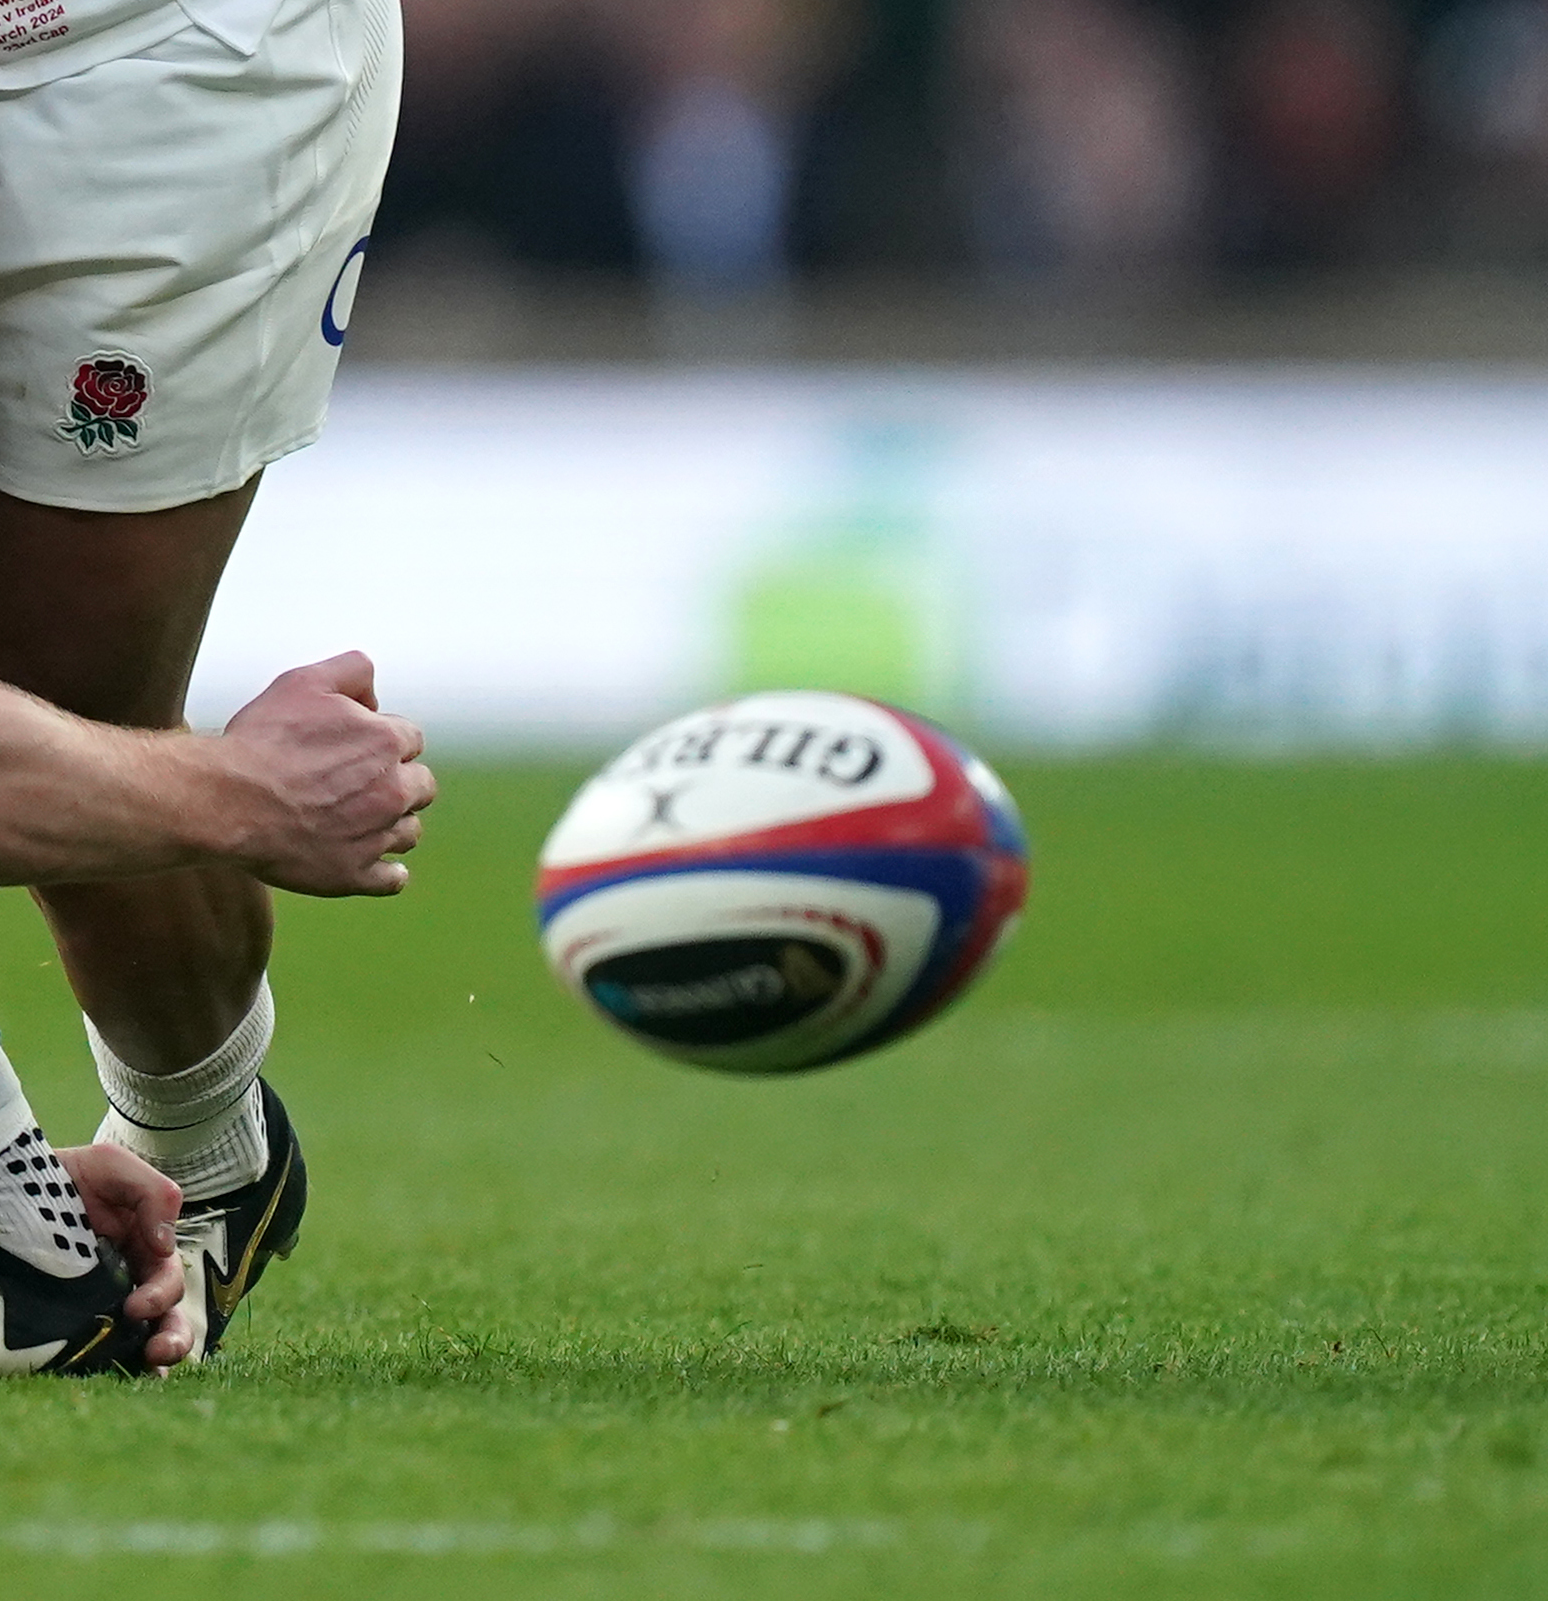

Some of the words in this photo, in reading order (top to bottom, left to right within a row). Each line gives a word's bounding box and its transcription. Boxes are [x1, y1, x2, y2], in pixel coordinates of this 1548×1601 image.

[2, 11, 12, 23] v
[29, 4, 65, 30] 2024
[38, 24, 69, 42] Cap
